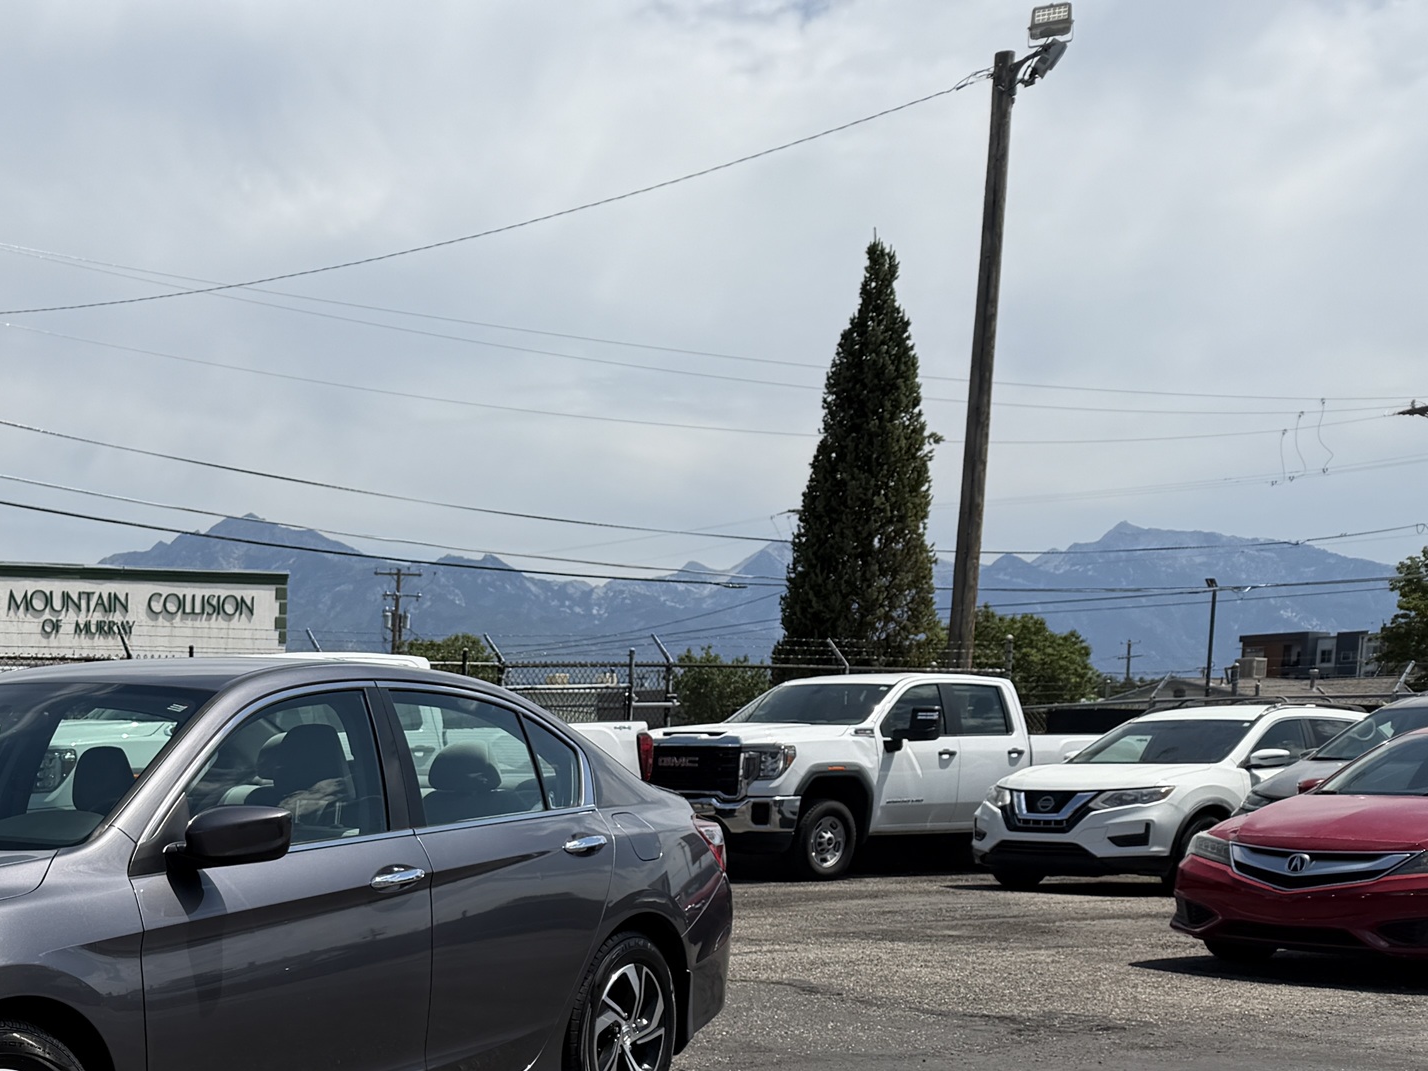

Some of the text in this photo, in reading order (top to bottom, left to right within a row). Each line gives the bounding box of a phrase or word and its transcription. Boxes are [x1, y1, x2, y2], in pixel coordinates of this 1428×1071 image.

[8, 589, 129, 613] MOUNTAIN
[147, 592, 255, 616] COLLISION
[41, 618, 63, 635] OF
[658, 756, 699, 767] GMC
